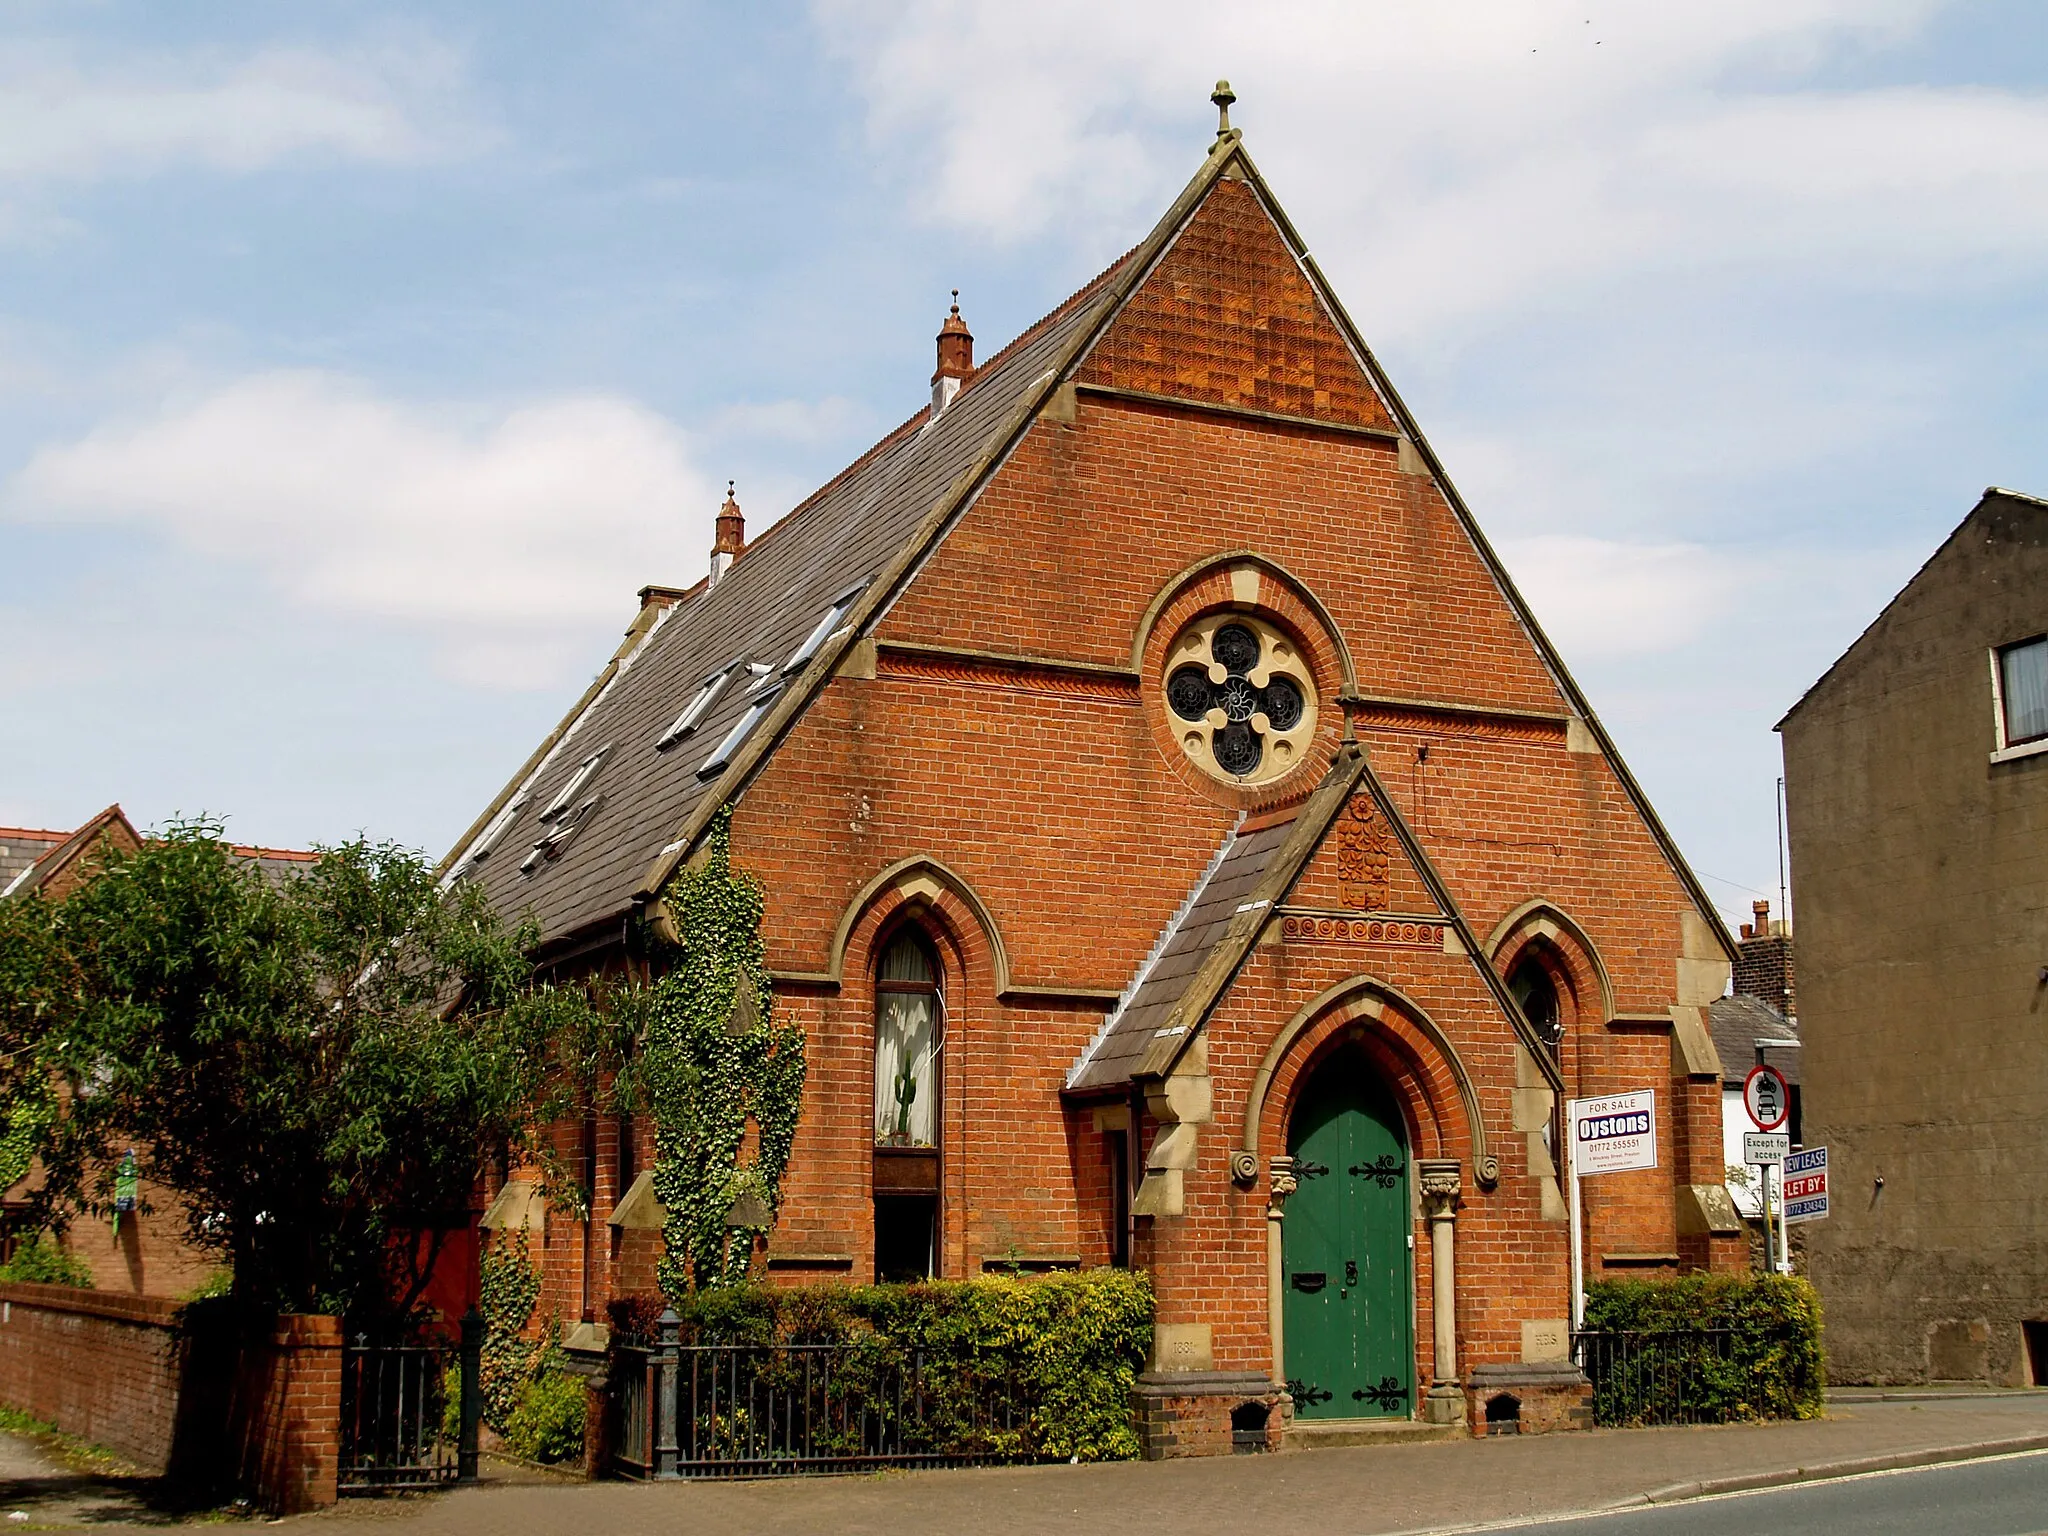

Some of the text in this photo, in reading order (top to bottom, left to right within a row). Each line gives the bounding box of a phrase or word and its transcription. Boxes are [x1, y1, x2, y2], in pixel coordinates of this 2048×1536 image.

[1589, 1099, 1636, 1113] FOR SALE
[1580, 1115, 1648, 1139] Oystons
[1589, 1139, 1640, 1153] 01772 555551
[1746, 1138, 1788, 1148] Except for
[1801, 1150, 1825, 1169] LEASE
[1787, 1177, 1820, 1196] LET BY
[1785, 1198, 1826, 1216] 01772 324342
